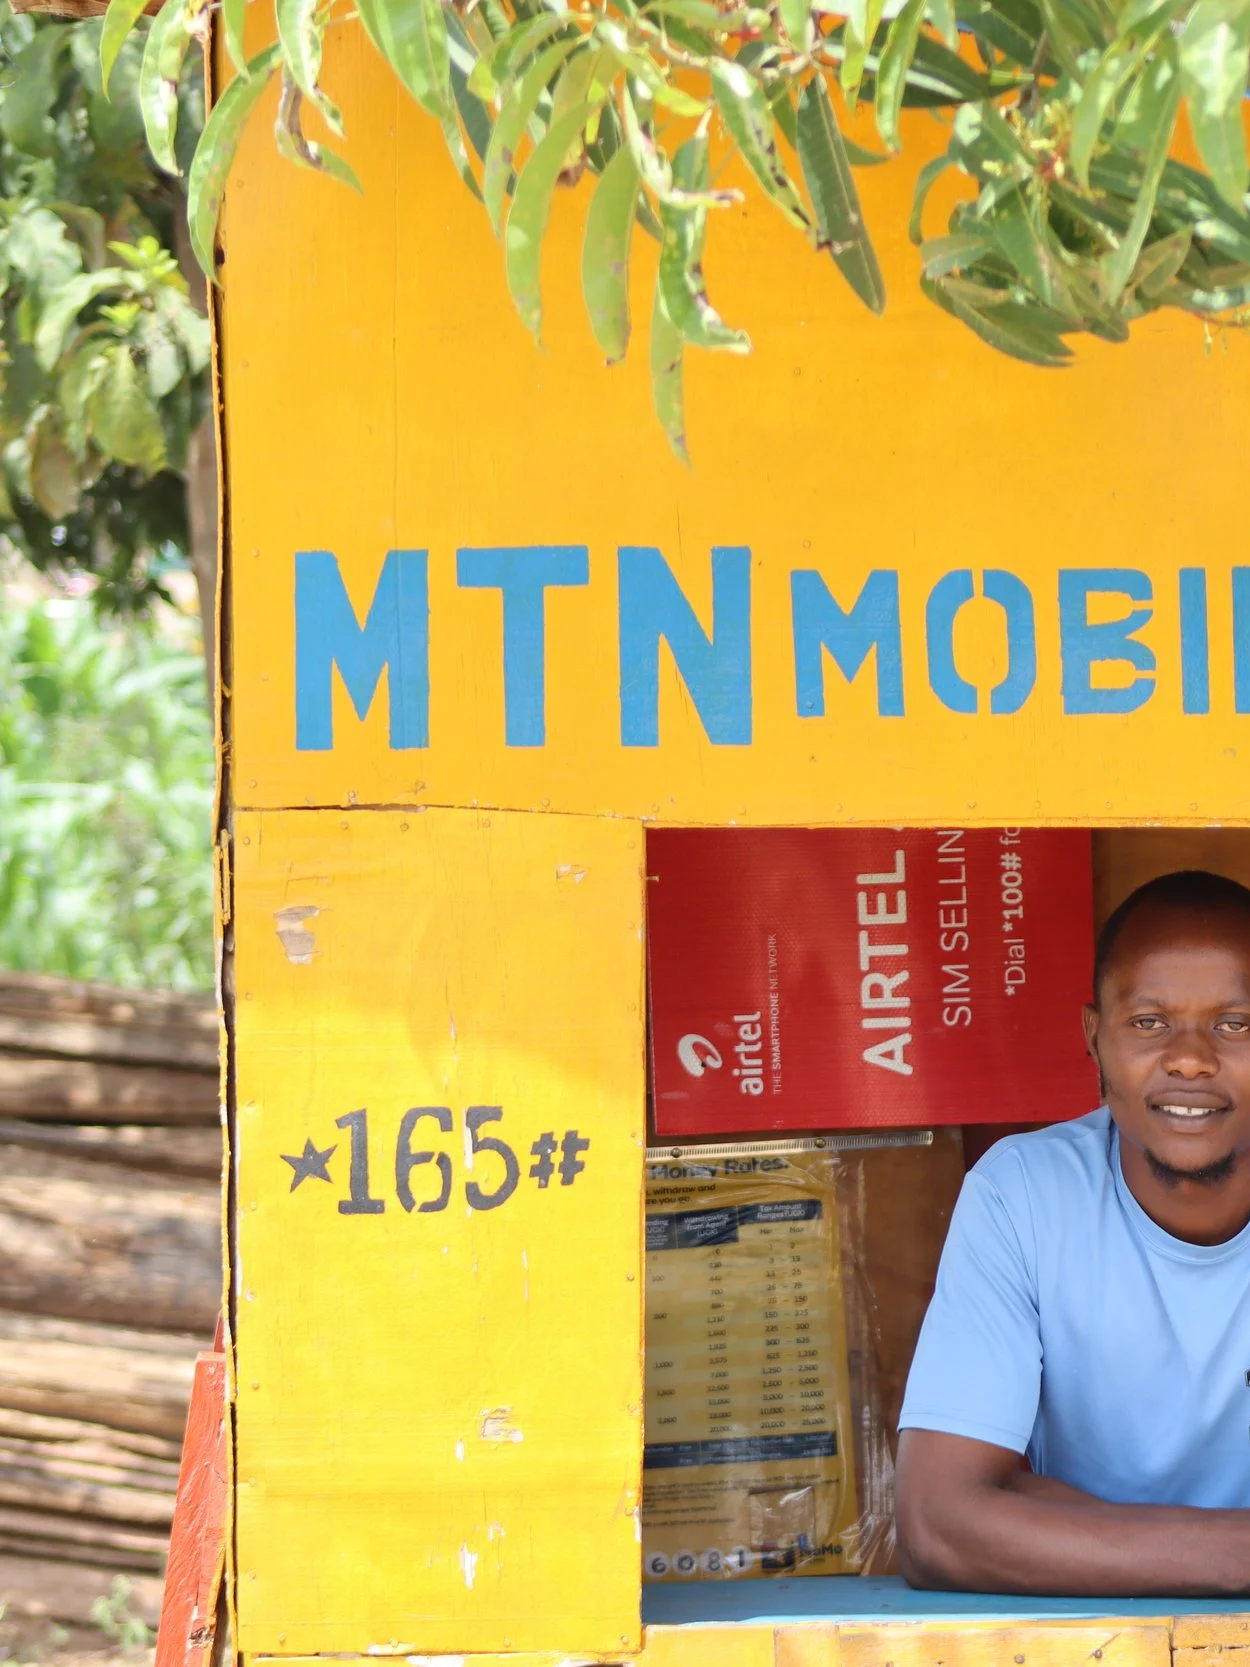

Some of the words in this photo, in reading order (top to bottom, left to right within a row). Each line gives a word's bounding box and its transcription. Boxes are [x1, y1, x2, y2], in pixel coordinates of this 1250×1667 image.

[295, 545, 752, 750] MTN
[936, 830, 969, 951] SELLIN
[768, 933, 778, 990] NETWORK
[856, 849, 913, 1076] AIRTEL
[942, 964, 972, 1026] SIM
[733, 1011, 764, 1096] airtel
[770, 992, 782, 1070] SMARTPHONE
[773, 1072, 782, 1094] THE
[652, 1163, 717, 1180] Money
[724, 1156, 789, 1174] Rates.
